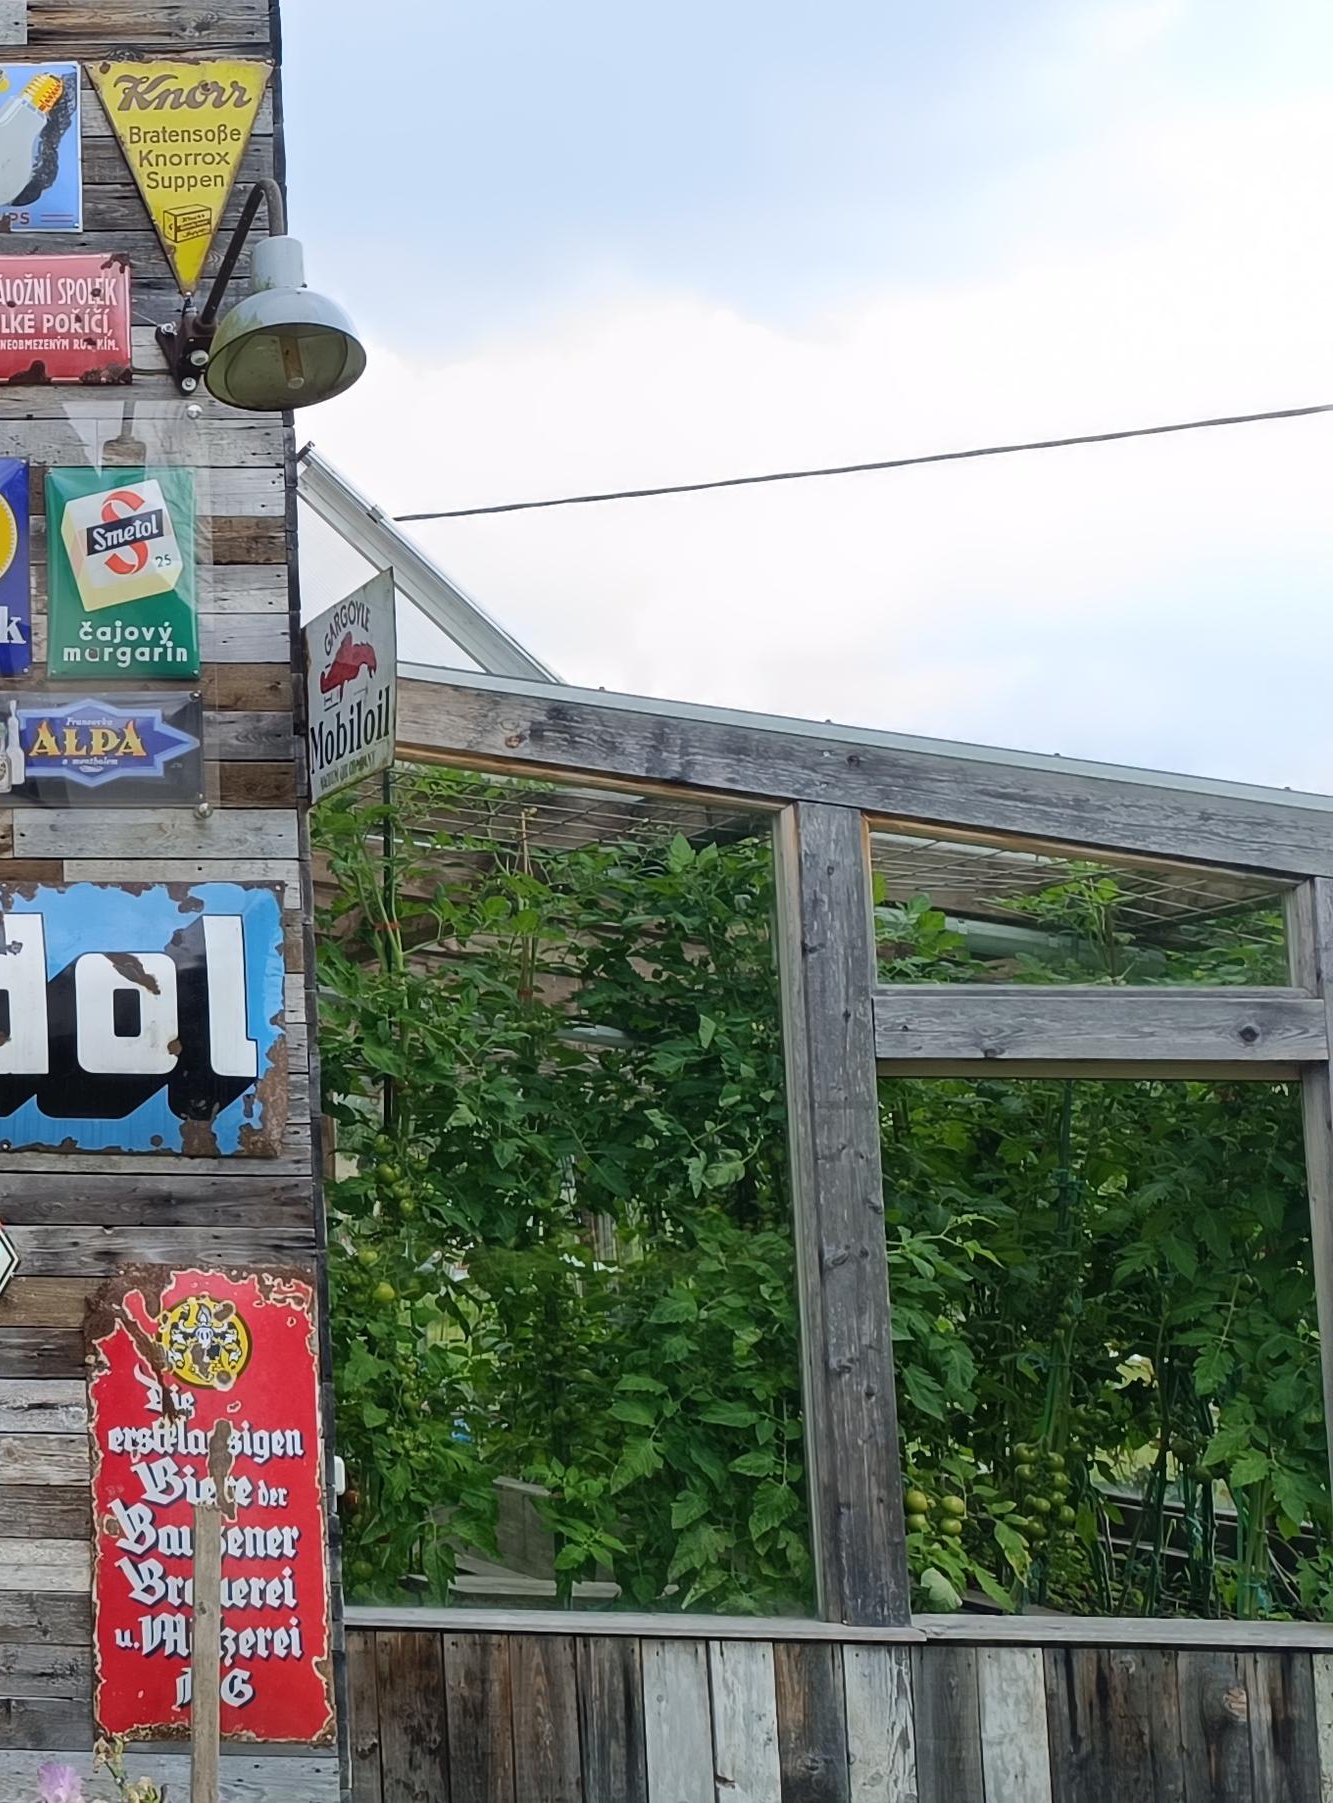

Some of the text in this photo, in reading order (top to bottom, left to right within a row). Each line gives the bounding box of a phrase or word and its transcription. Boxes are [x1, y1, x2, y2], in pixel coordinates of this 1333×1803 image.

[113, 74, 252, 111] Knorr
[129, 124, 241, 145] Bratensoße
[139, 150, 230, 168] Knorrox
[146, 171, 225, 192] Suppen
[57, 277, 117, 306] SPOLEK
[91, 516, 161, 553] Smetol
[80, 619, 173, 645] čajový
[324, 600, 370, 657] GARGOYLE
[28, 720, 147, 757] ALPA
[310, 685, 391, 775] Mobiloil
[257, 1479, 289, 1508] der
